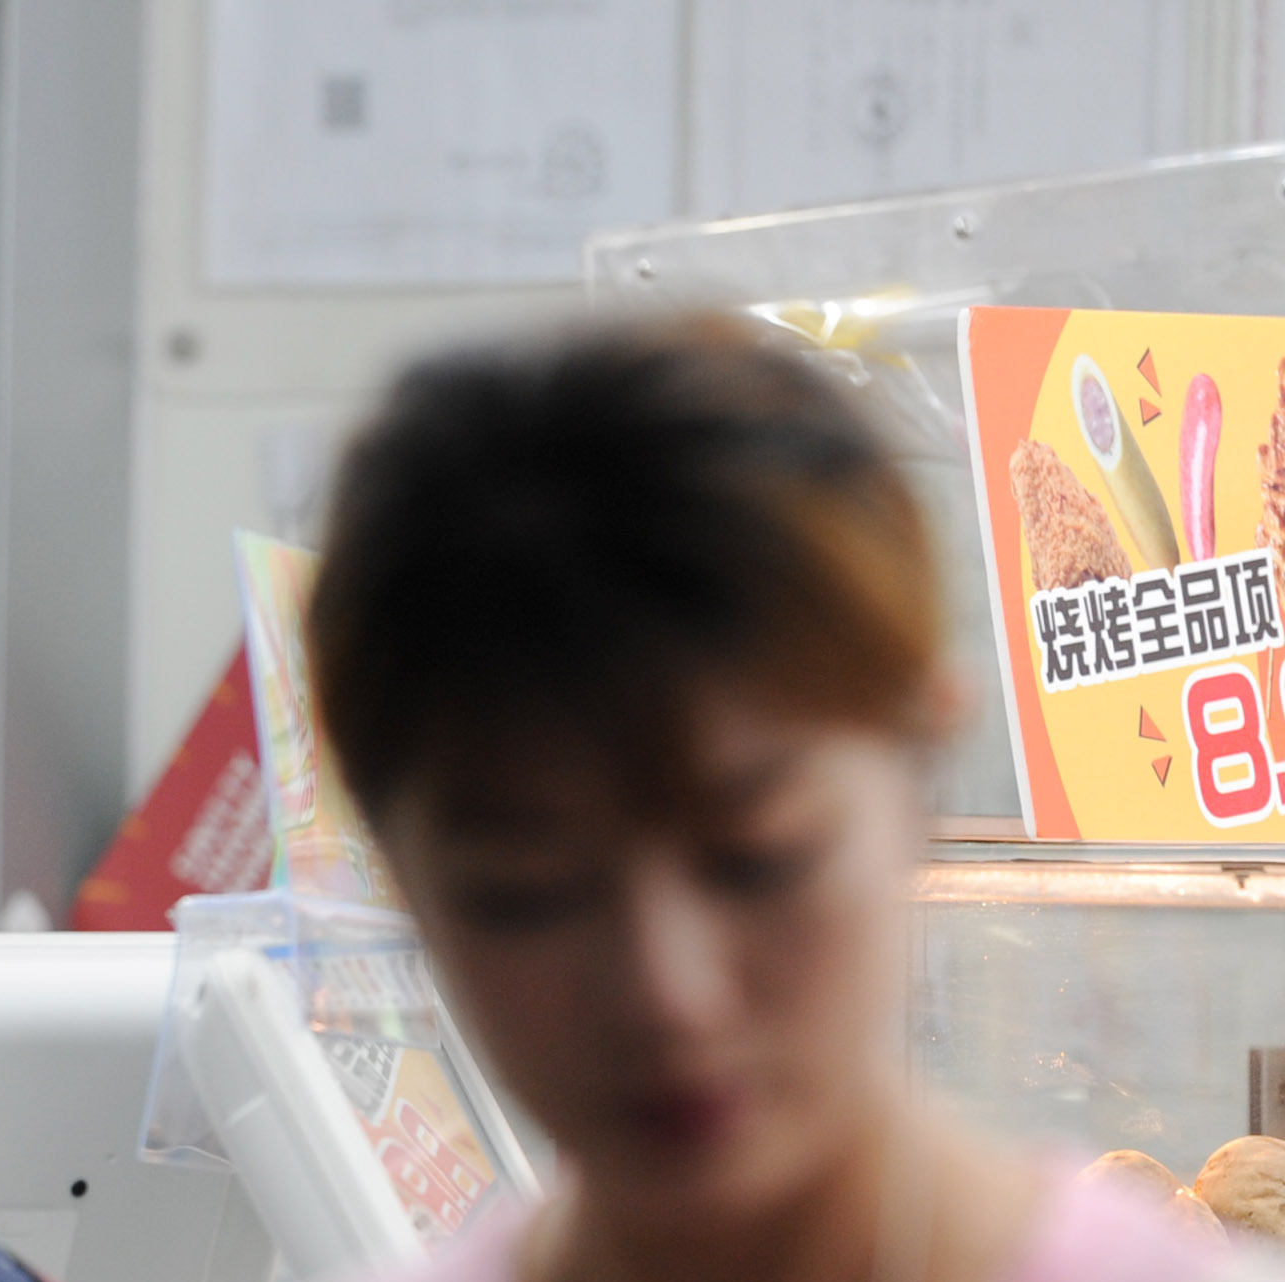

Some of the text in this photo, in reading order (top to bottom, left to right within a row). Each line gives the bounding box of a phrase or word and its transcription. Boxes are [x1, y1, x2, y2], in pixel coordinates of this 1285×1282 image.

[1035, 557, 1279, 684] 烧烤全品项
[1186, 672, 1285, 819] 8
